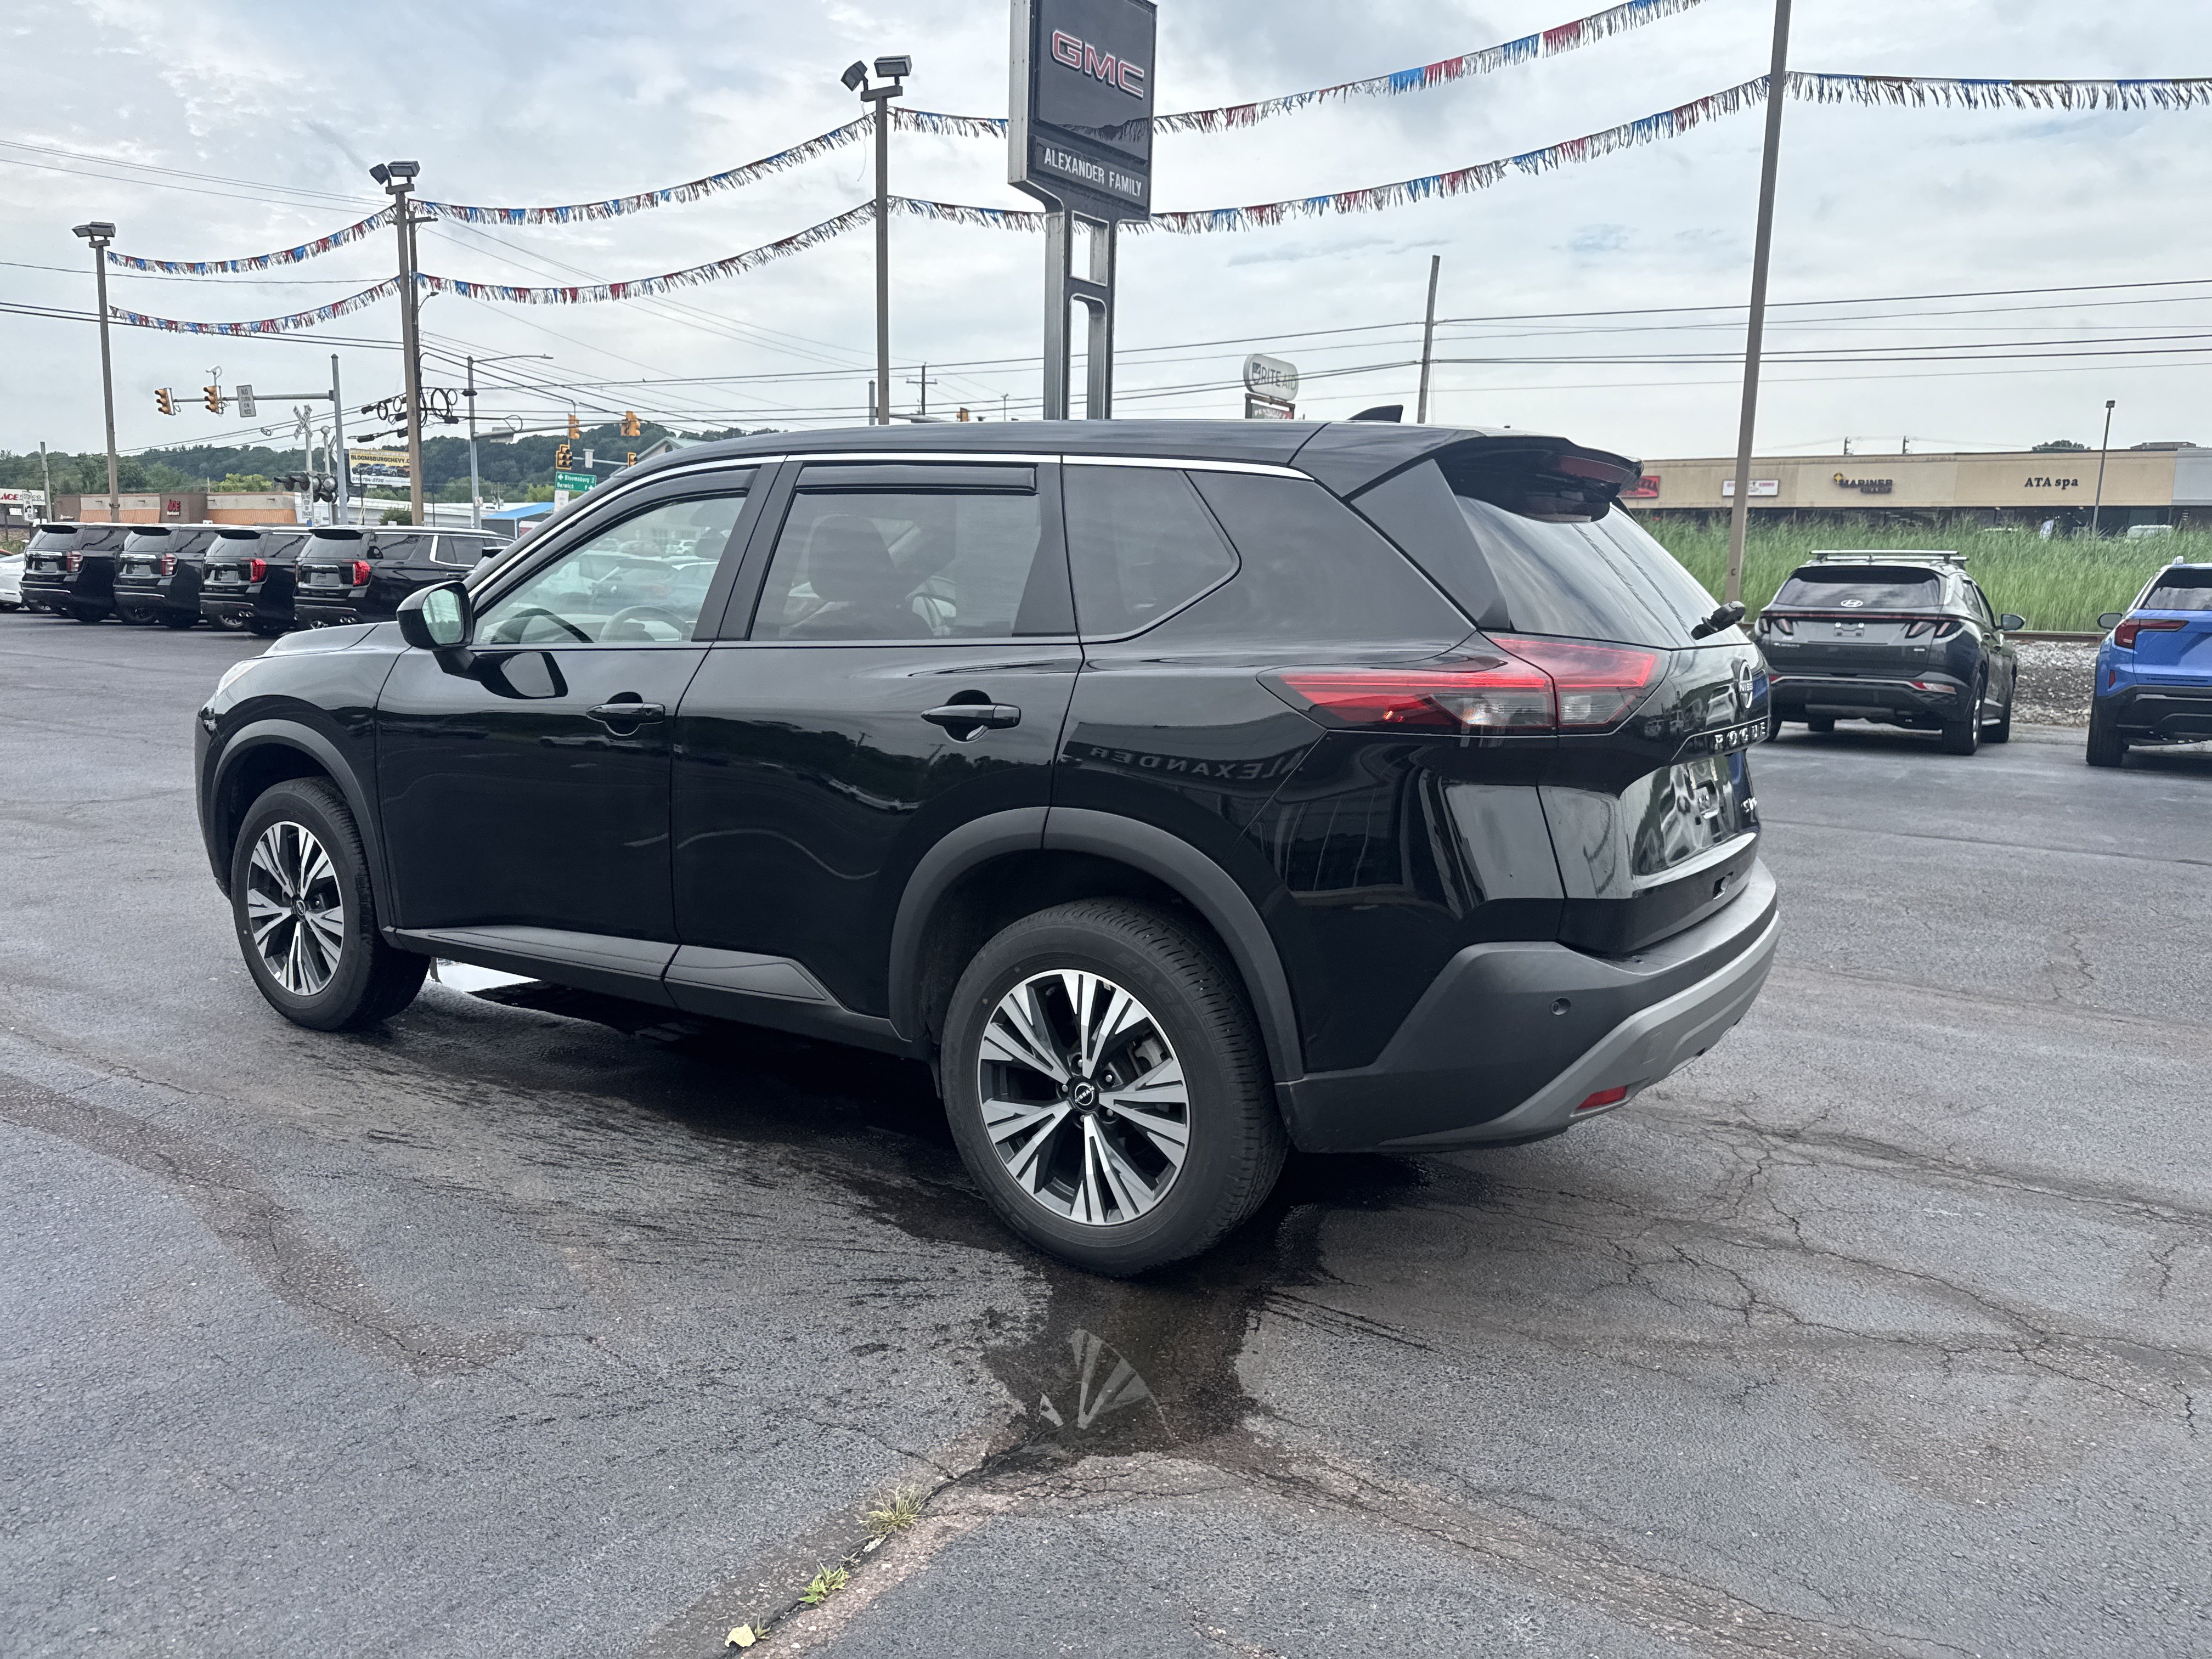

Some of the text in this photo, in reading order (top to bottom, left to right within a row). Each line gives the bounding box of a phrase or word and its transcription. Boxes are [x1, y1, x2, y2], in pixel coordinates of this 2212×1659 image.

[1052, 29, 1144, 99] GMC
[1044, 147, 1142, 197] ALEXANDER FAMILY
[1261, 366, 1297, 391] RITE AID
[351, 454, 410, 464] BLOOMSBURGCHEVY.C
[2024, 477, 2079, 490] ATA spa
[167, 499, 180, 511] ACE
[1714, 721, 1766, 751] ROGUE
[1074, 1086, 1095, 1103] NISSAN
